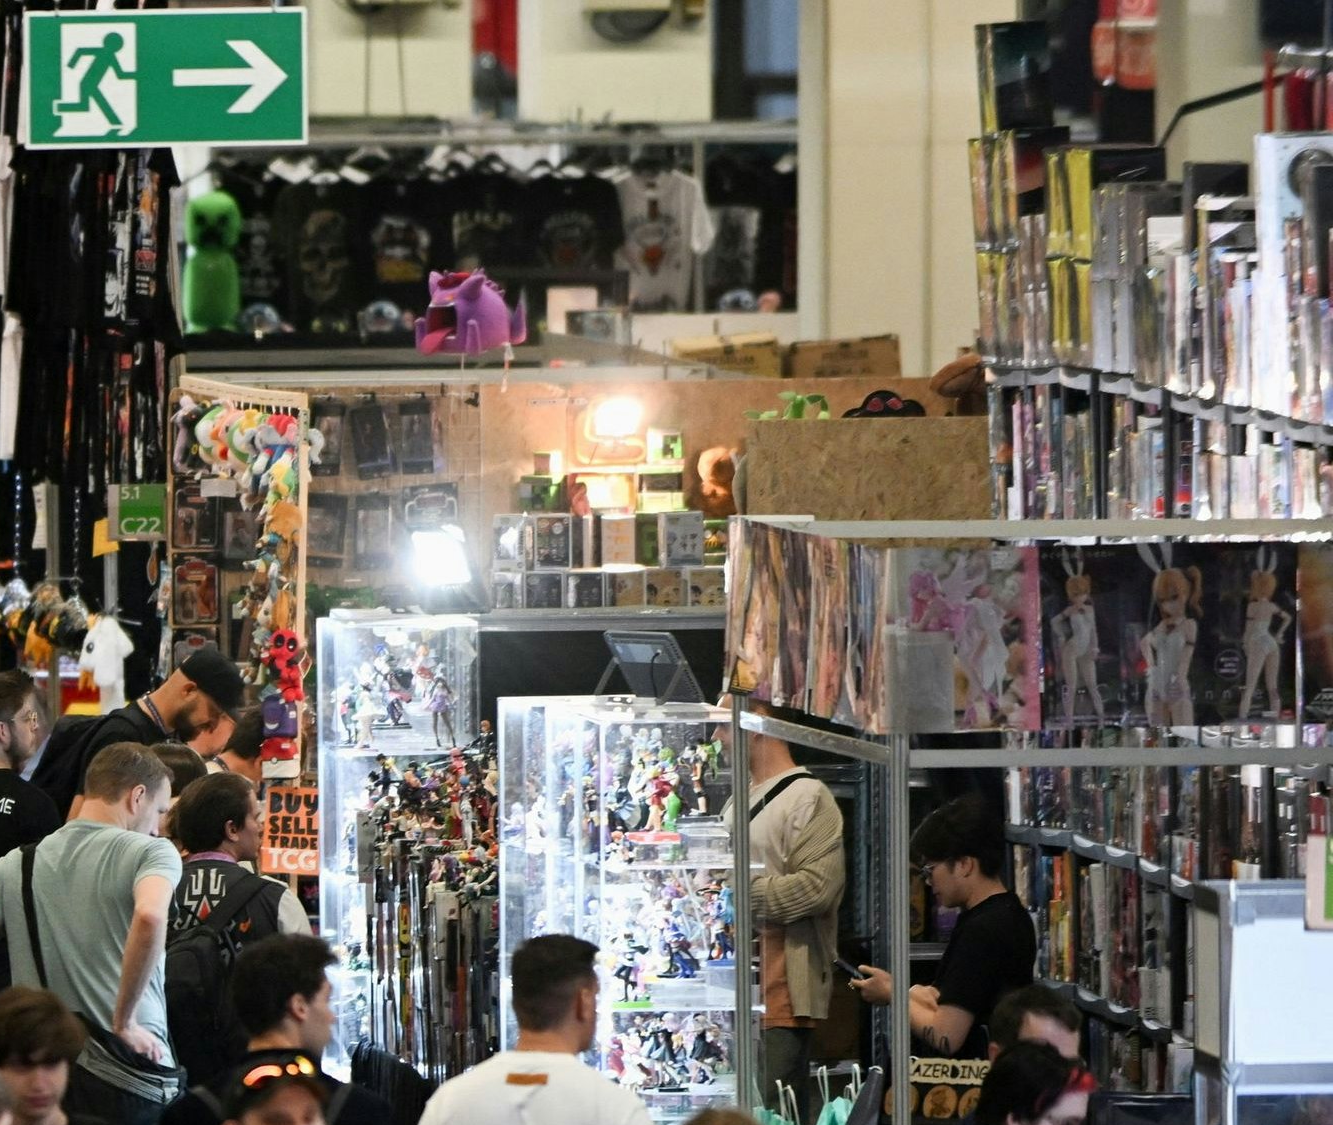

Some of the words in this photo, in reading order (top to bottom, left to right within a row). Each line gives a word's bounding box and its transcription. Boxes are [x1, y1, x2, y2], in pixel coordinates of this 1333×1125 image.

[121, 485, 141, 500] 5.1
[120, 516, 162, 536] C22
[269, 791, 319, 817] BUY
[268, 815, 319, 836] SELL
[268, 834, 318, 850] TRADE
[269, 848, 317, 871] TCG
